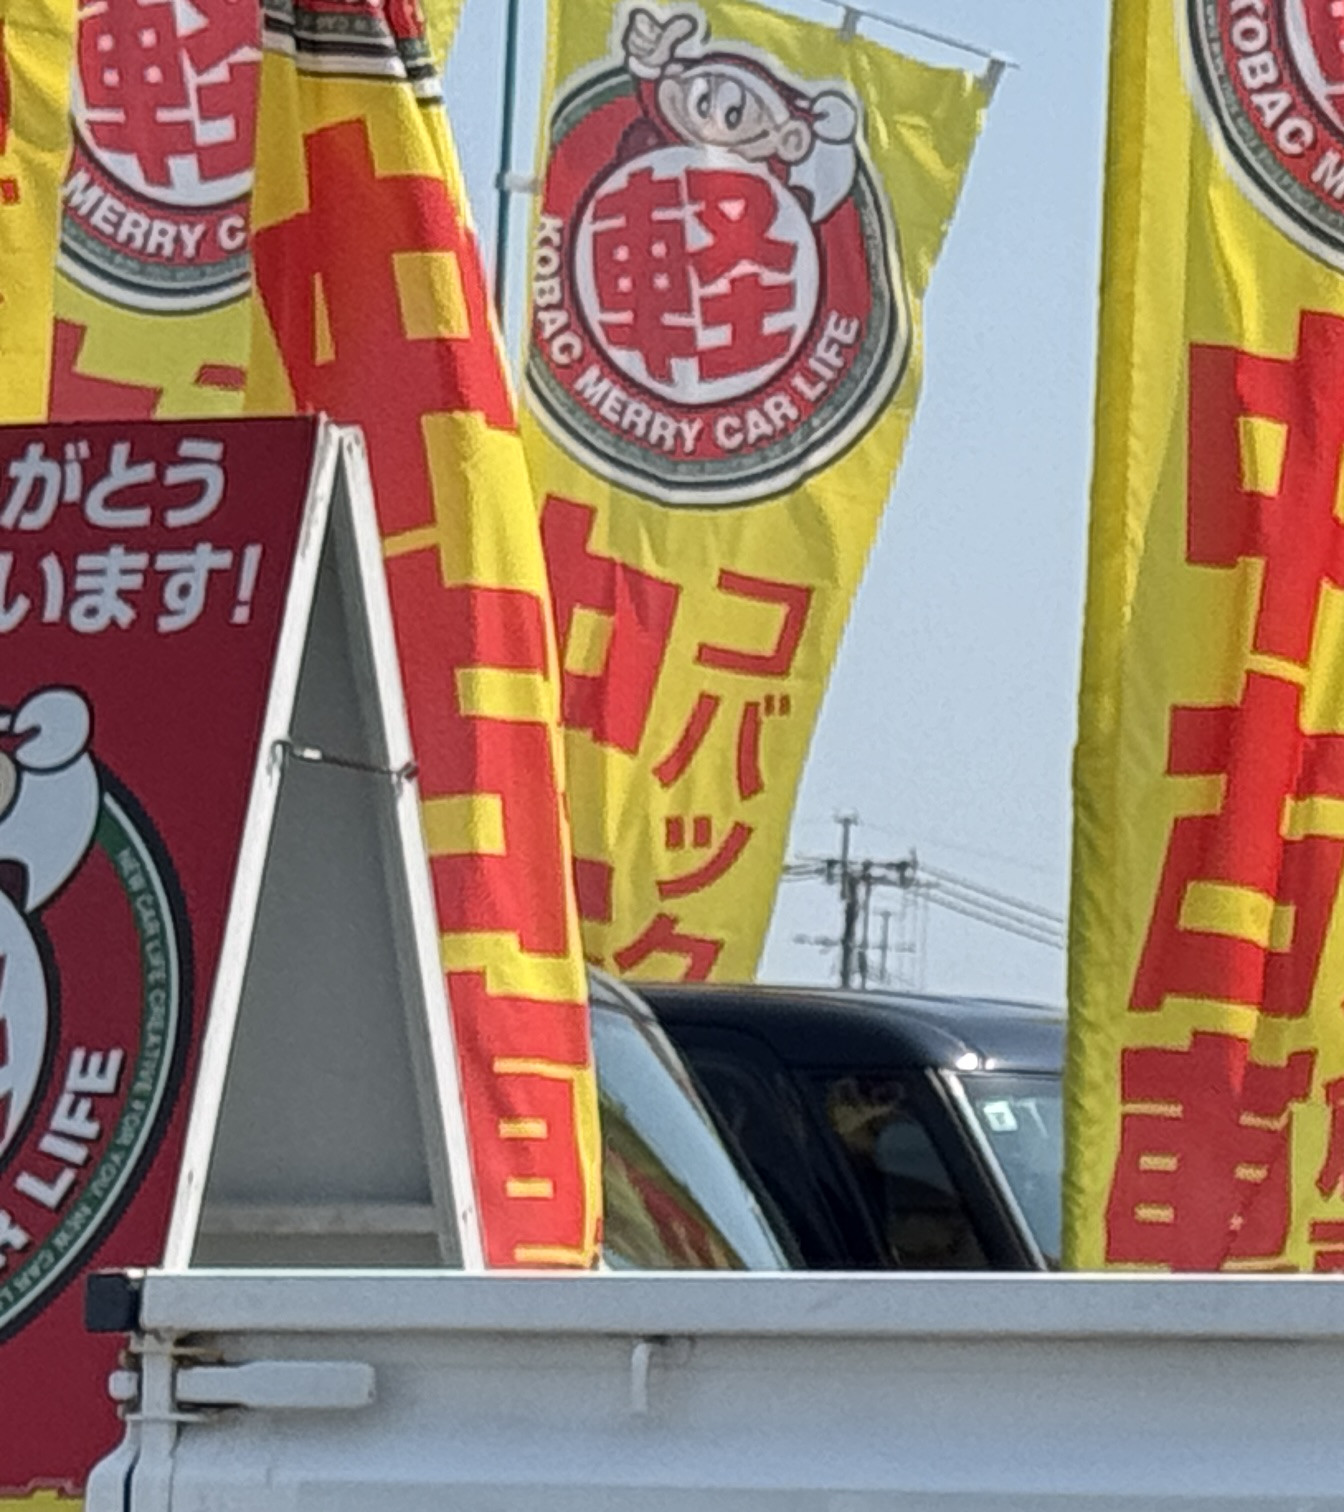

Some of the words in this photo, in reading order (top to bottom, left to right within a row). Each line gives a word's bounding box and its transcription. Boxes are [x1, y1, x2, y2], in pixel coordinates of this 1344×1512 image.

[63, 169, 205, 258] MERRY
[532, 214, 584, 367] KOBAC
[574, 367, 702, 454] MERRY
[715, 395, 800, 450] CAR
[791, 311, 860, 402] LIFE
[0, 438, 225, 530] がとう
[15, 1045, 124, 1209] LIFE
